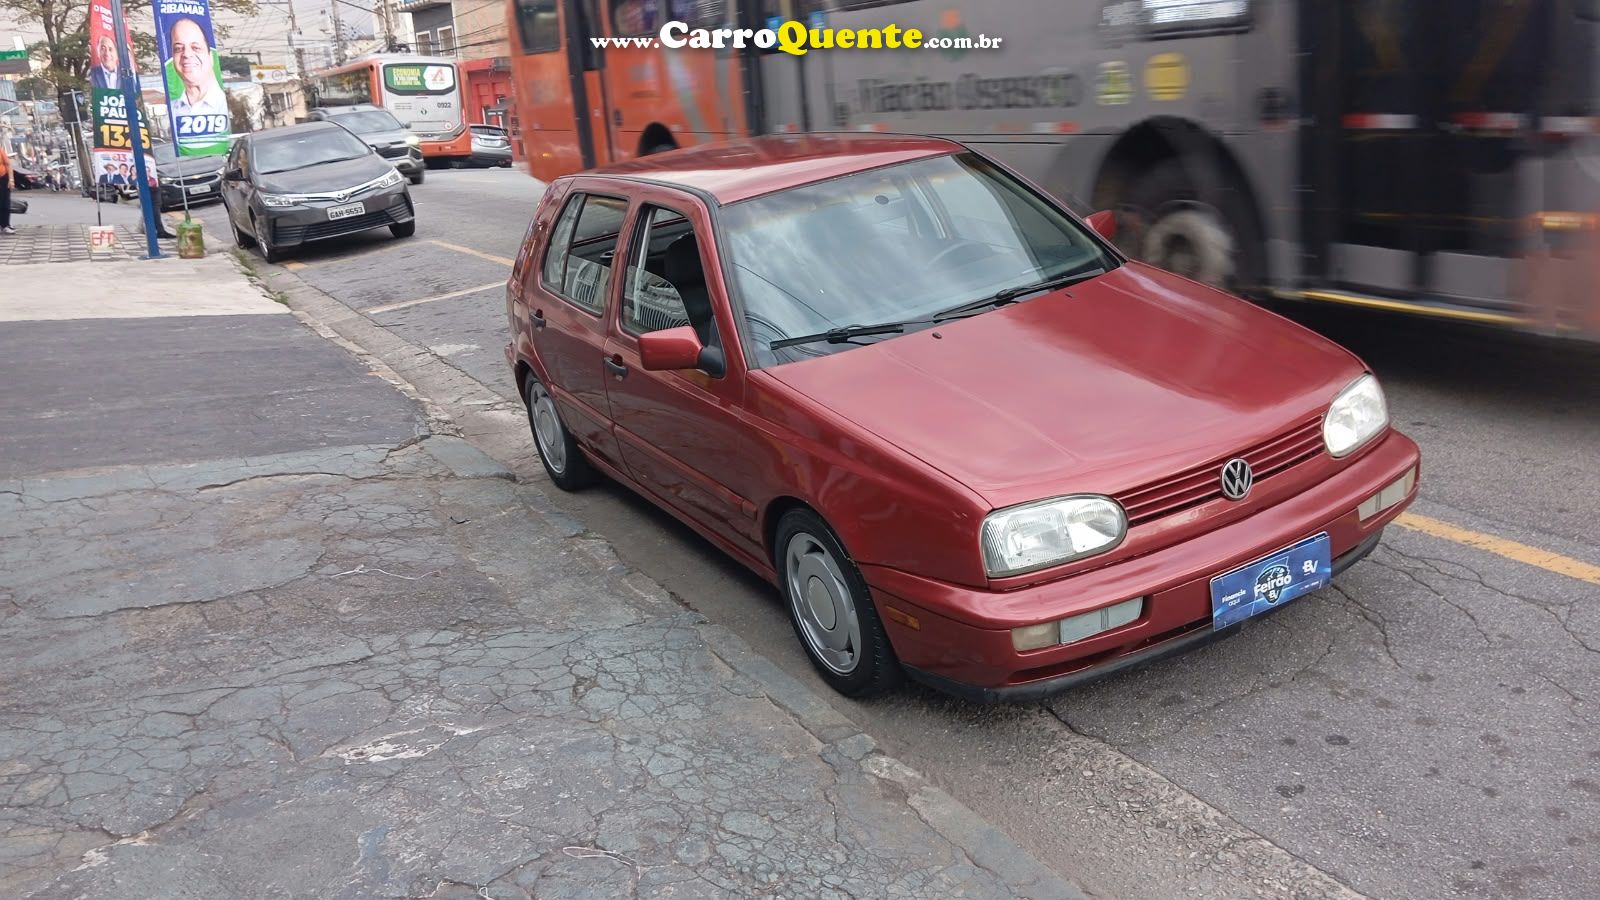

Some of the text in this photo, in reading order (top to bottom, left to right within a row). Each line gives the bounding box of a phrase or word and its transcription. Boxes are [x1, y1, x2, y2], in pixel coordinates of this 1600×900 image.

[160, 4, 205, 16] RIBAMAR
[180, 115, 226, 133] 2019
[1253, 573, 1292, 597] Feirão
[1222, 589, 1246, 603] Financie
